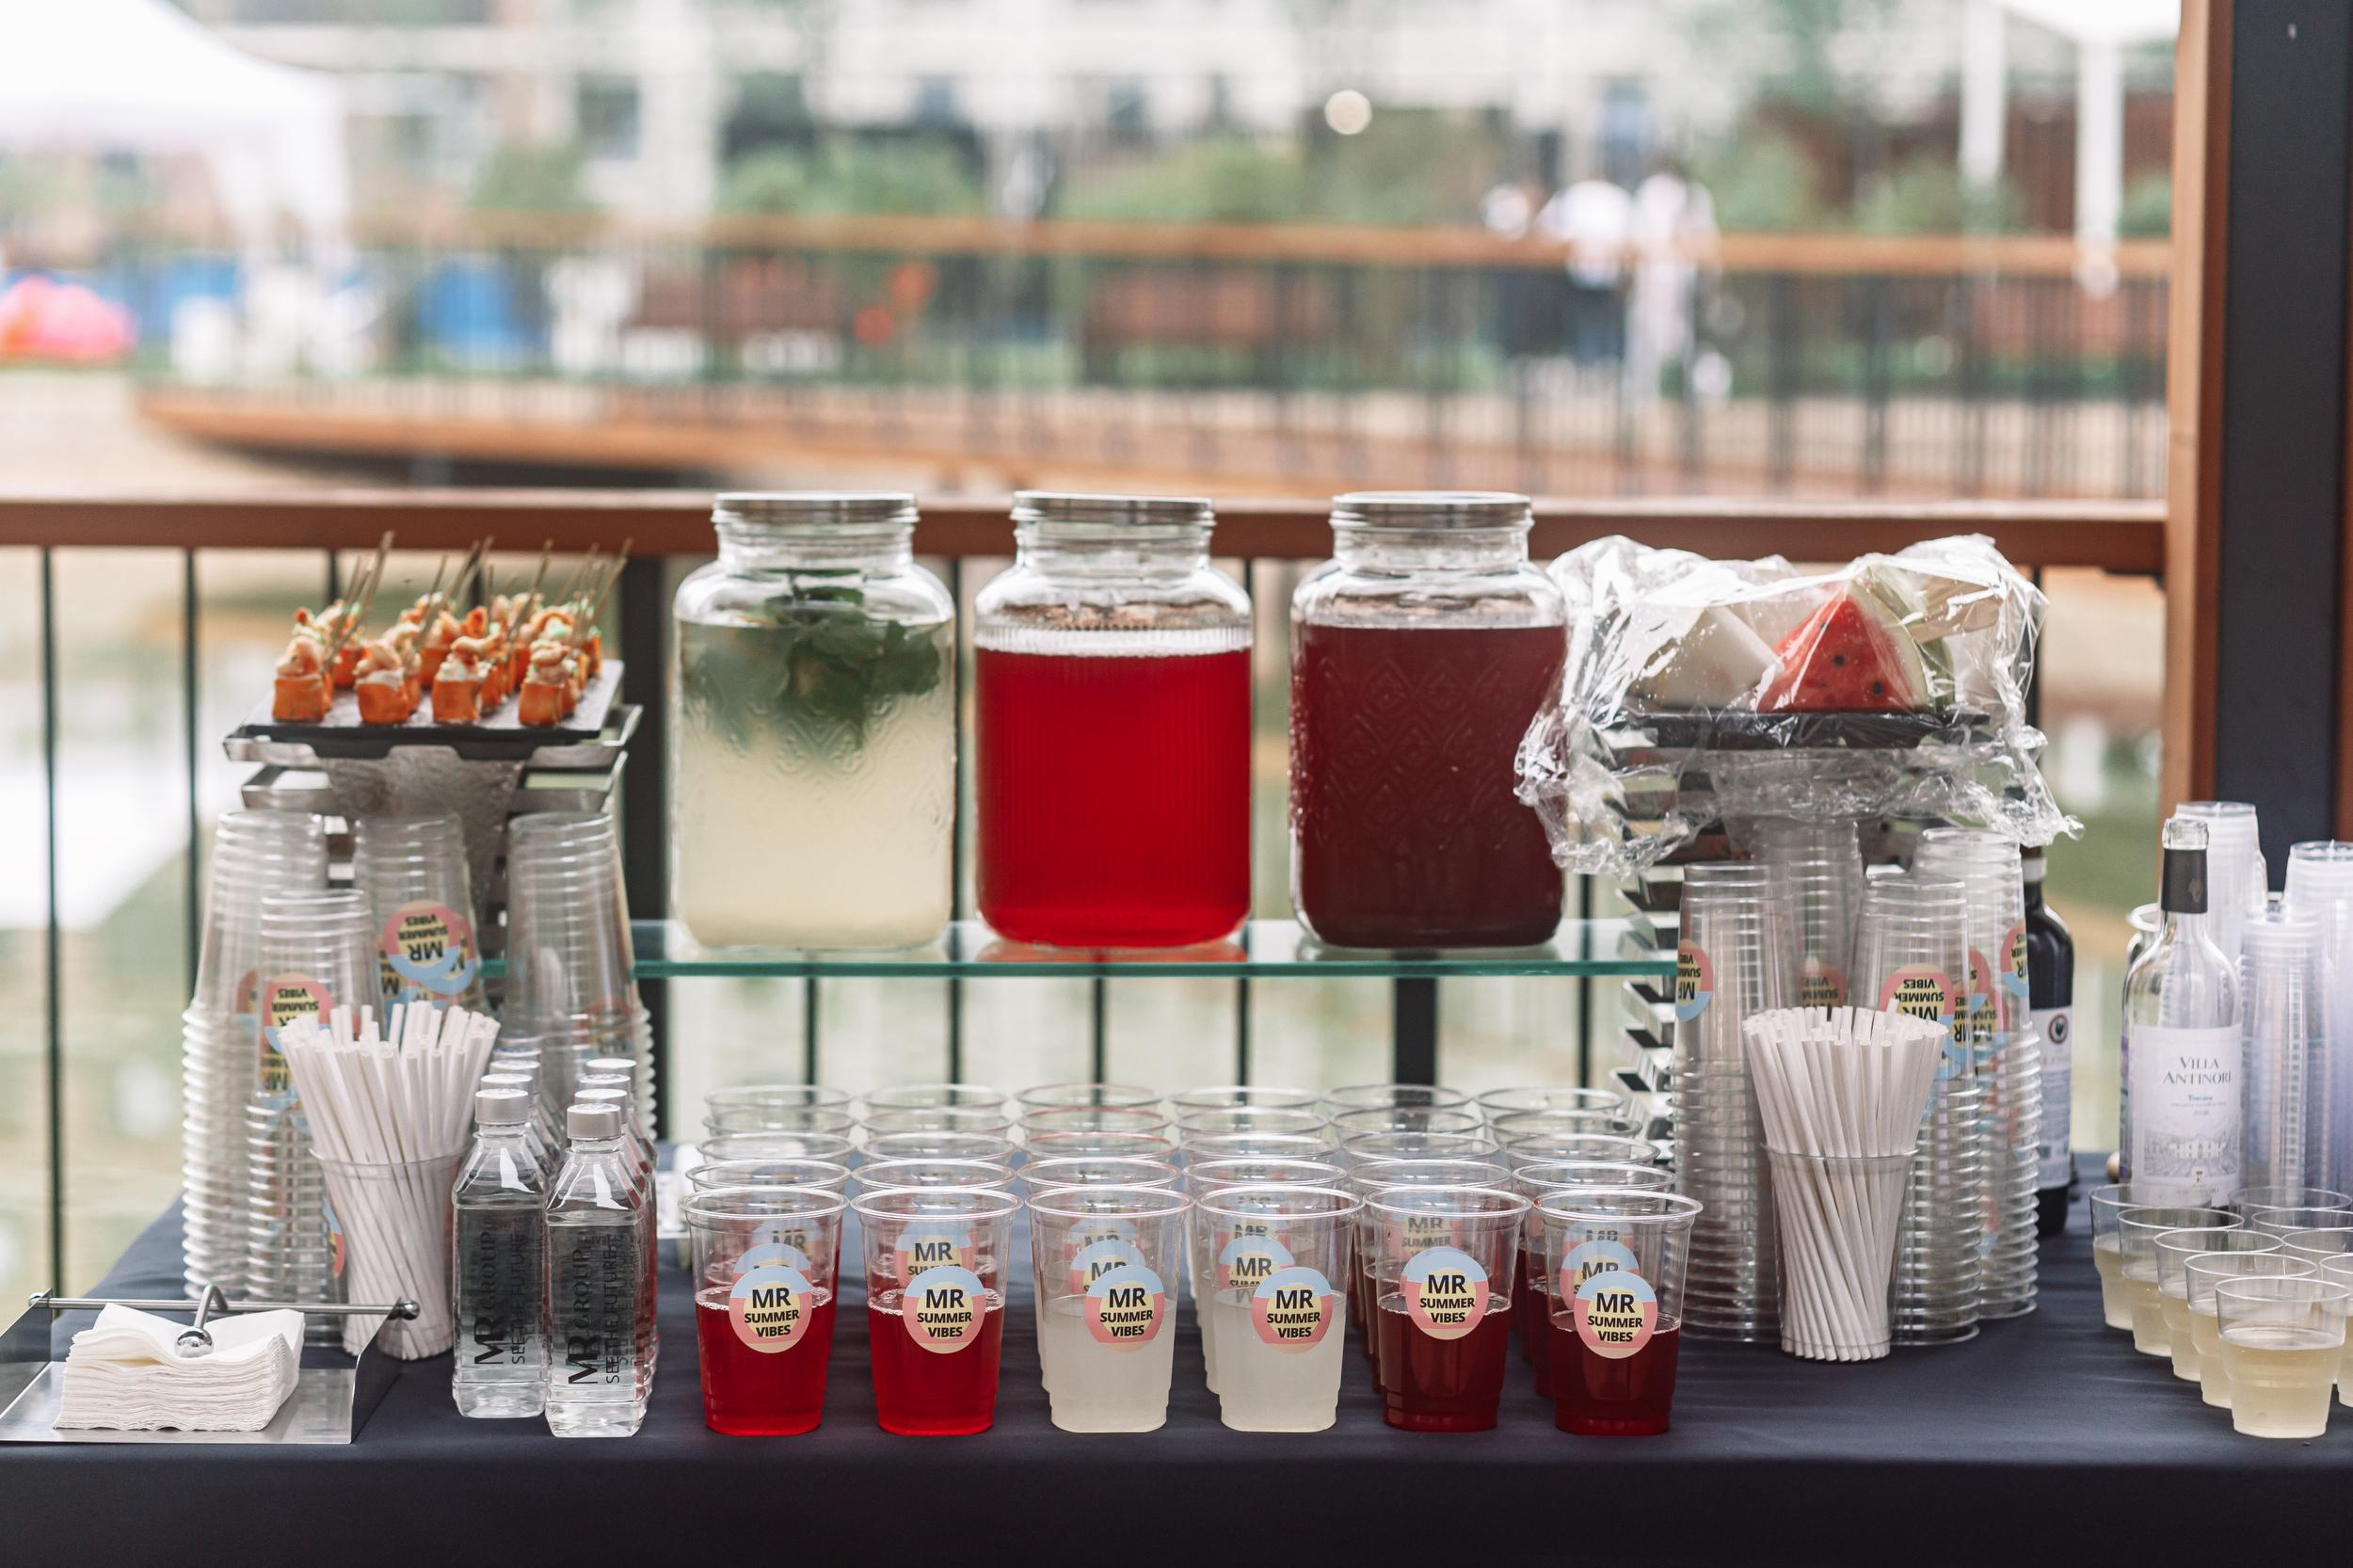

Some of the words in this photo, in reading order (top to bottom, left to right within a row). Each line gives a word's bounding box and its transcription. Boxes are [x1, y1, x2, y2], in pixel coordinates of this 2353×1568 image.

[407, 942, 444, 962] MR
[1903, 979, 1936, 988] VIBES
[2180, 1056, 2220, 1069] VILLA
[2163, 1071, 2232, 1085] ANTINORI
[915, 1241, 952, 1262] MR
[479, 1231, 497, 1310] GROUP
[1091, 1261, 1128, 1282] M
[1236, 1257, 1273, 1277] MR
[572, 1249, 589, 1329] GROUP
[1428, 1274, 1466, 1294] MR
[752, 1288, 792, 1309] MR
[926, 1288, 965, 1309] MR
[1109, 1288, 1146, 1309] MR
[1275, 1289, 1314, 1310] MR
[1419, 1298, 1476, 1309] SUMMER
[1596, 1292, 1635, 1314] MR
[744, 1309, 800, 1324] SUMMER
[917, 1312, 972, 1324] SUMMER
[1099, 1309, 1154, 1323] SUMMER
[1266, 1311, 1321, 1324] SUMMER
[1431, 1312, 1466, 1323] VIBES
[1587, 1315, 1643, 1328] SUMMER
[474, 1317, 504, 1365] MR
[756, 1324, 792, 1338] VIBES
[927, 1326, 963, 1338] VIBES
[1112, 1325, 1145, 1337] VIBES
[1278, 1326, 1312, 1338] VIBES
[1598, 1330, 1633, 1342] VIBES
[511, 1336, 525, 1365] SEE
[568, 1335, 600, 1384] MR
[605, 1355, 619, 1384] SEE
